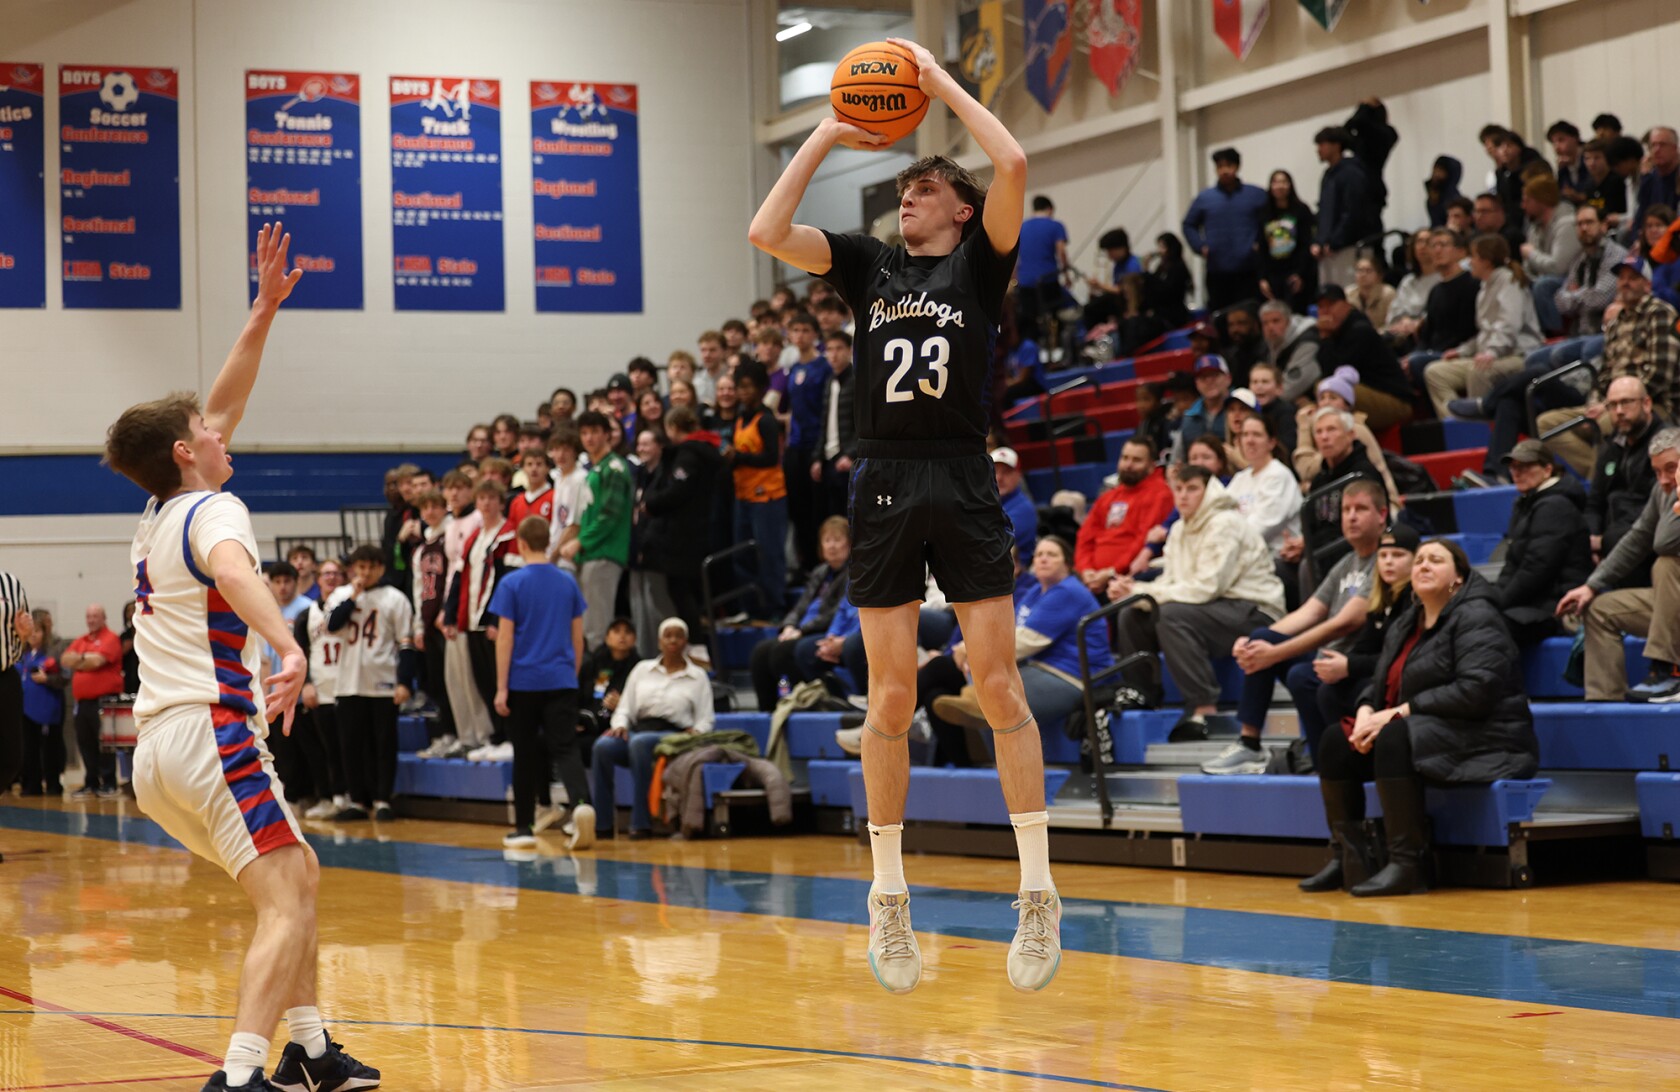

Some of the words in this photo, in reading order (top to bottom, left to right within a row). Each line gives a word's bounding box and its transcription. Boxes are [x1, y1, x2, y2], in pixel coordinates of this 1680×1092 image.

[63, 71, 100, 84] BOYS
[850, 61, 898, 77] NCAA
[248, 75, 286, 89] BOYS
[842, 92, 907, 112] Wilson
[91, 108, 146, 126] Soccer
[275, 111, 332, 129] Tennis
[422, 117, 470, 135] Track
[63, 126, 147, 143] Conference
[249, 129, 332, 146] Conference
[63, 169, 130, 188] Regional
[250, 187, 319, 205] Sectional
[64, 216, 135, 233] Sectional
[110, 263, 150, 279] State
[295, 254, 334, 272] State
[439, 257, 477, 275] State
[577, 268, 615, 285] State
[868, 291, 965, 333] Bulldogs
[884, 336, 950, 403] 23
[347, 607, 378, 649] 54
[323, 642, 342, 666] 11
